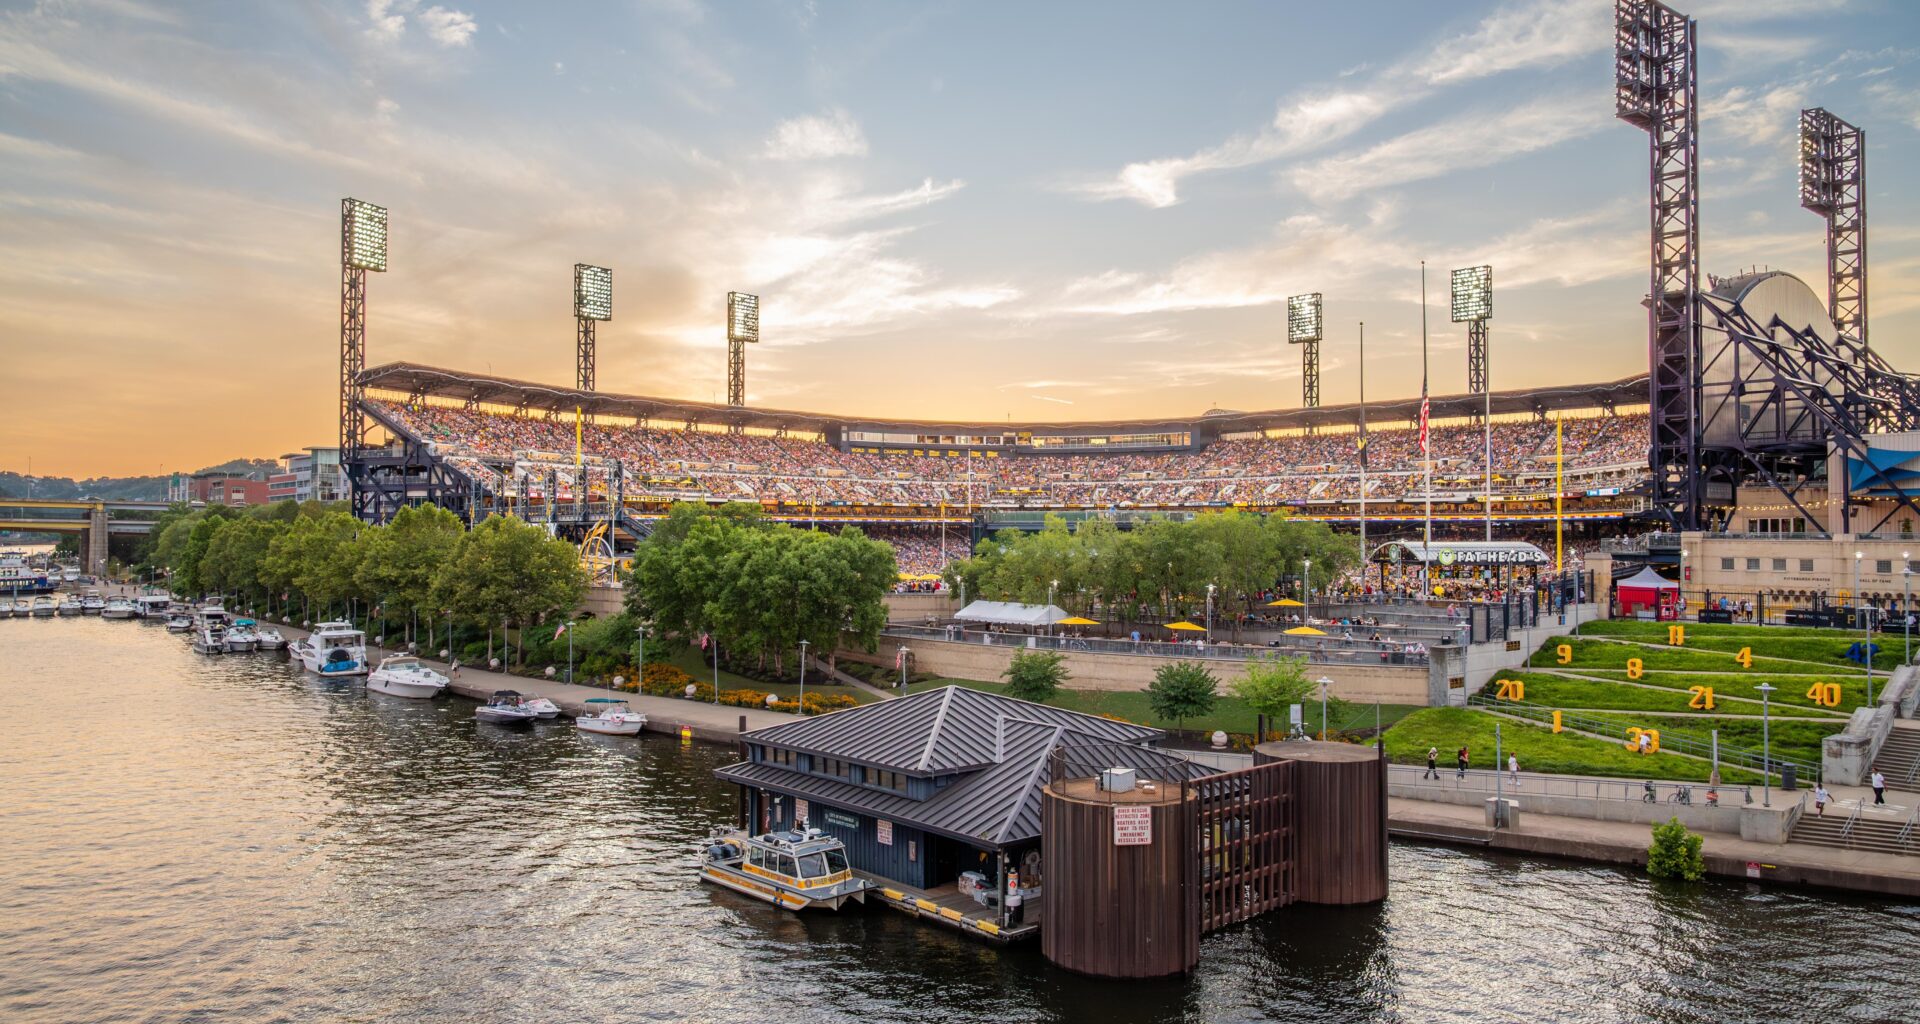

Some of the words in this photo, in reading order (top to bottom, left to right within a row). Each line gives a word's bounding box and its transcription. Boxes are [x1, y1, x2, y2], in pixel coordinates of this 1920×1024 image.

[1457, 551, 1482, 562] FAT
[1487, 551, 1541, 562] HEAD'S
[1847, 614, 1856, 624] P
[1668, 625, 1684, 646] 11
[1557, 644, 1572, 664] 9
[1735, 647, 1752, 668] 4
[1627, 658, 1643, 679] 8
[1496, 679, 1525, 701] 20
[1688, 685, 1716, 710] 21
[1806, 681, 1841, 707] 40
[1552, 710, 1562, 734] 1
